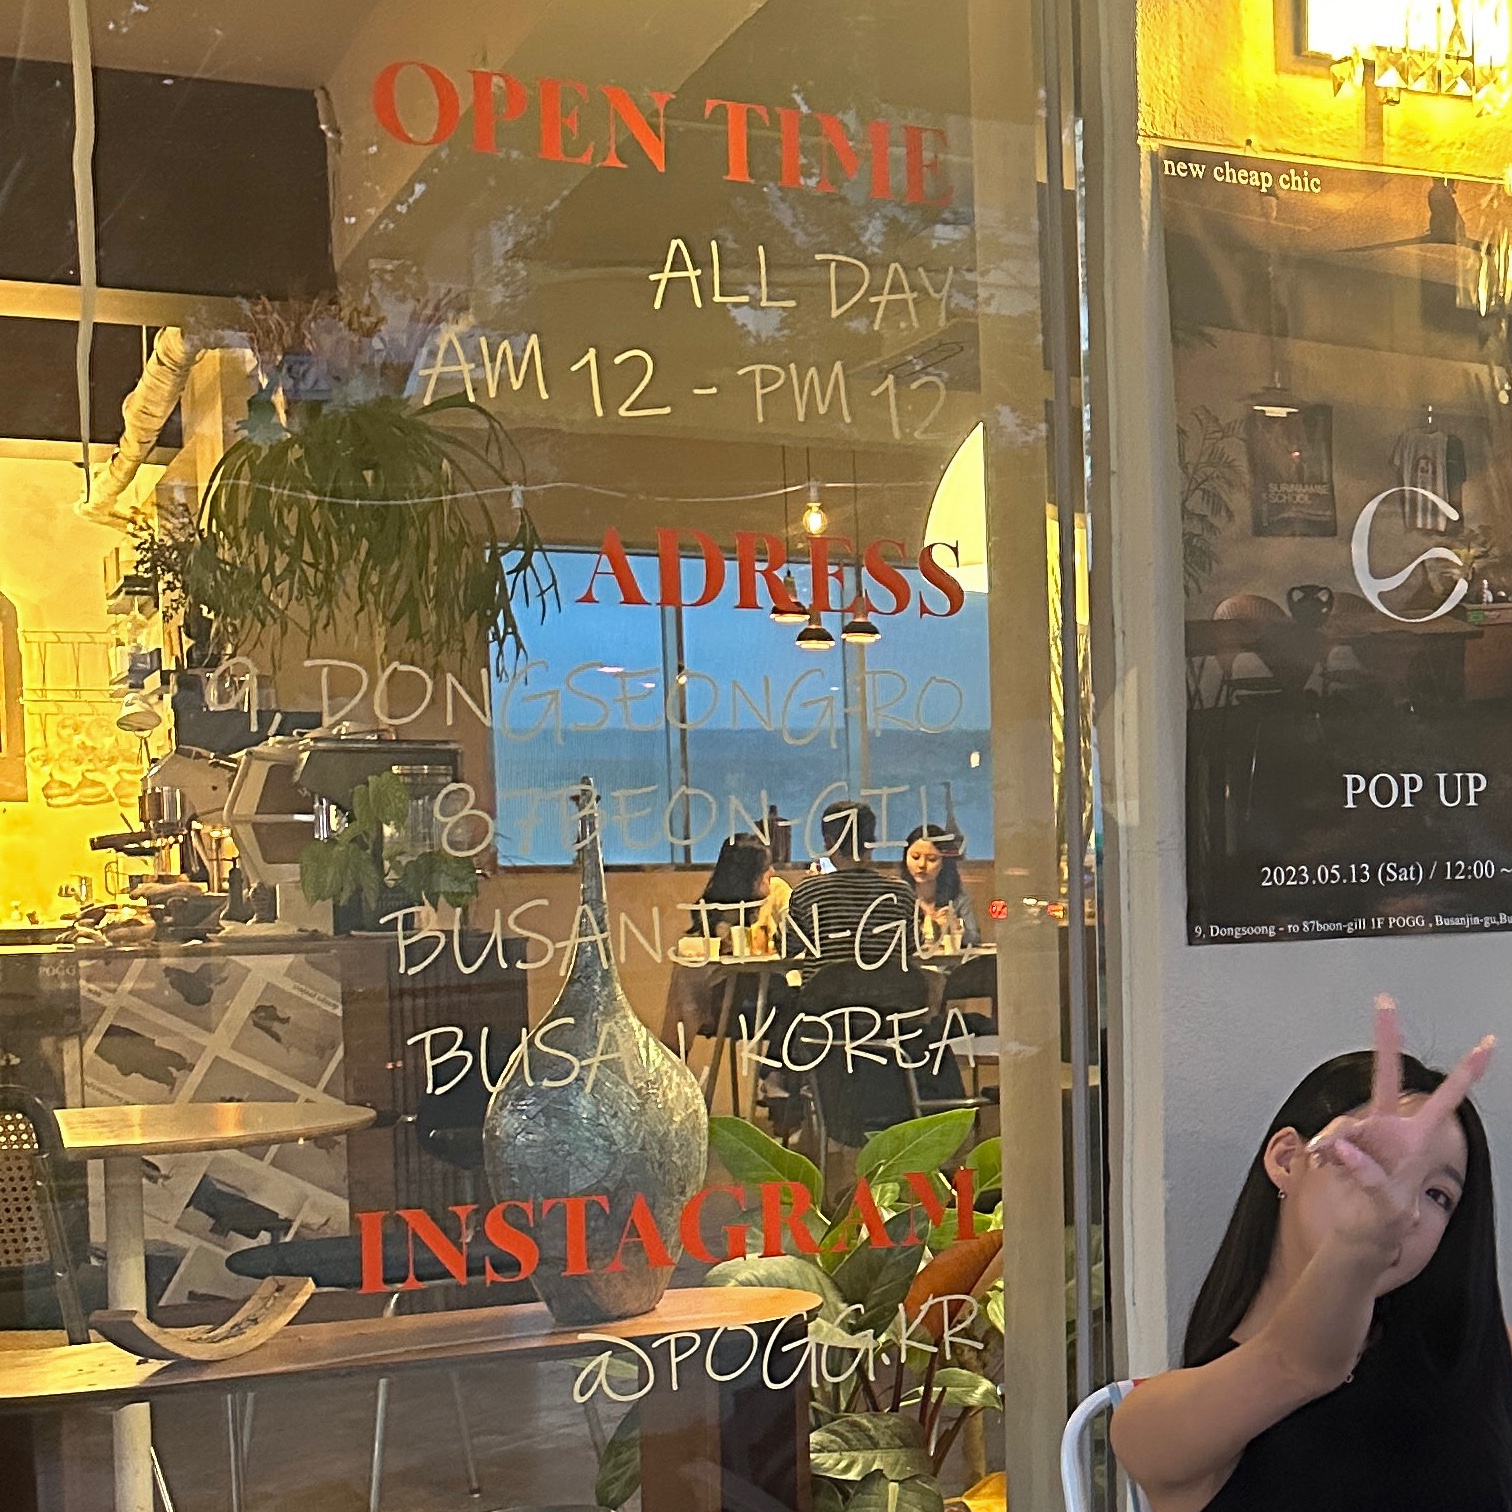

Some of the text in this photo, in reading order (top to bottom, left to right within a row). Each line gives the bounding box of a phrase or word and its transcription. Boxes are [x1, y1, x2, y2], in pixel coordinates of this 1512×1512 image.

[372, 60, 954, 207] OPEN TIME
[1163, 159, 1322, 194] new cheap chic
[649, 238, 954, 331] ALL DAY
[418, 330, 548, 406] AM
[571, 347, 672, 417] 12
[737, 360, 852, 423] PM
[870, 374, 947, 441] 12
[575, 525, 965, 619] ADRESS
[303, 658, 964, 750] DONGSEONG-RO
[1342, 772, 1488, 809] POP UP
[1260, 863, 1371, 887] 2023.05.13
[1377, 861, 1424, 886] (Sat)
[1429, 860, 1438, 880] /
[1445, 859, 1496, 880] 12:00
[378, 892, 973, 976] BUSANJIN-GU,
[1194, 926, 1206, 939] 9,
[1210, 924, 1277, 939] Dongsoong
[1287, 924, 1300, 933] ro
[1302, 917, 1367, 934] 87boon-gill
[1371, 917, 1385, 929] 1F
[1388, 915, 1425, 929] POGG
[739, 1006, 976, 1077] KOREA
[357, 1167, 980, 1294] INSTAGRAM
[573, 1294, 985, 1402] @POGG.KR
